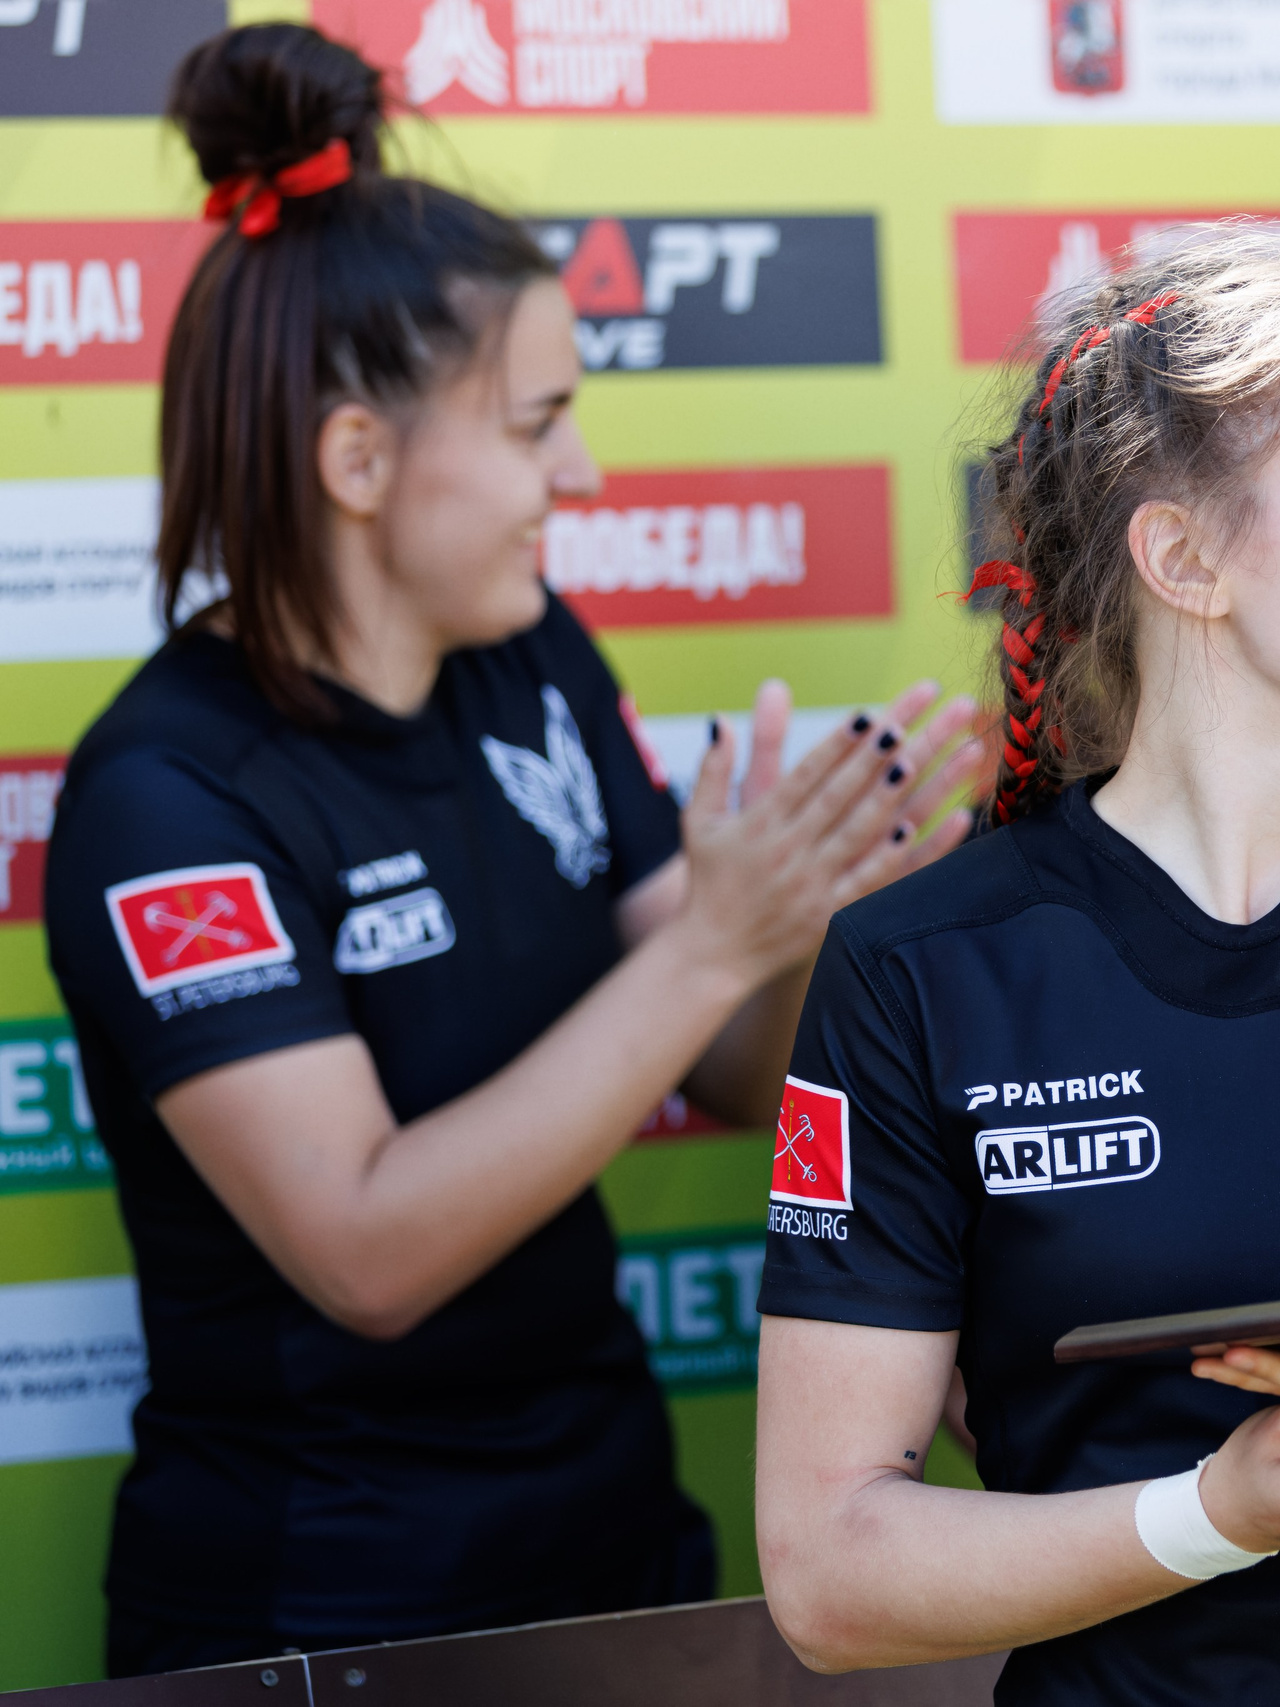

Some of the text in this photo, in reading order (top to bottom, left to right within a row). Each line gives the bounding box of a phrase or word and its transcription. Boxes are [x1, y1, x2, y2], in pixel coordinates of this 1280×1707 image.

[543, 502, 806, 602] ПОБЕДА!
[1003, 1069, 1145, 1107] PATRICK
[983, 1128, 1149, 1181] ARLIFT
